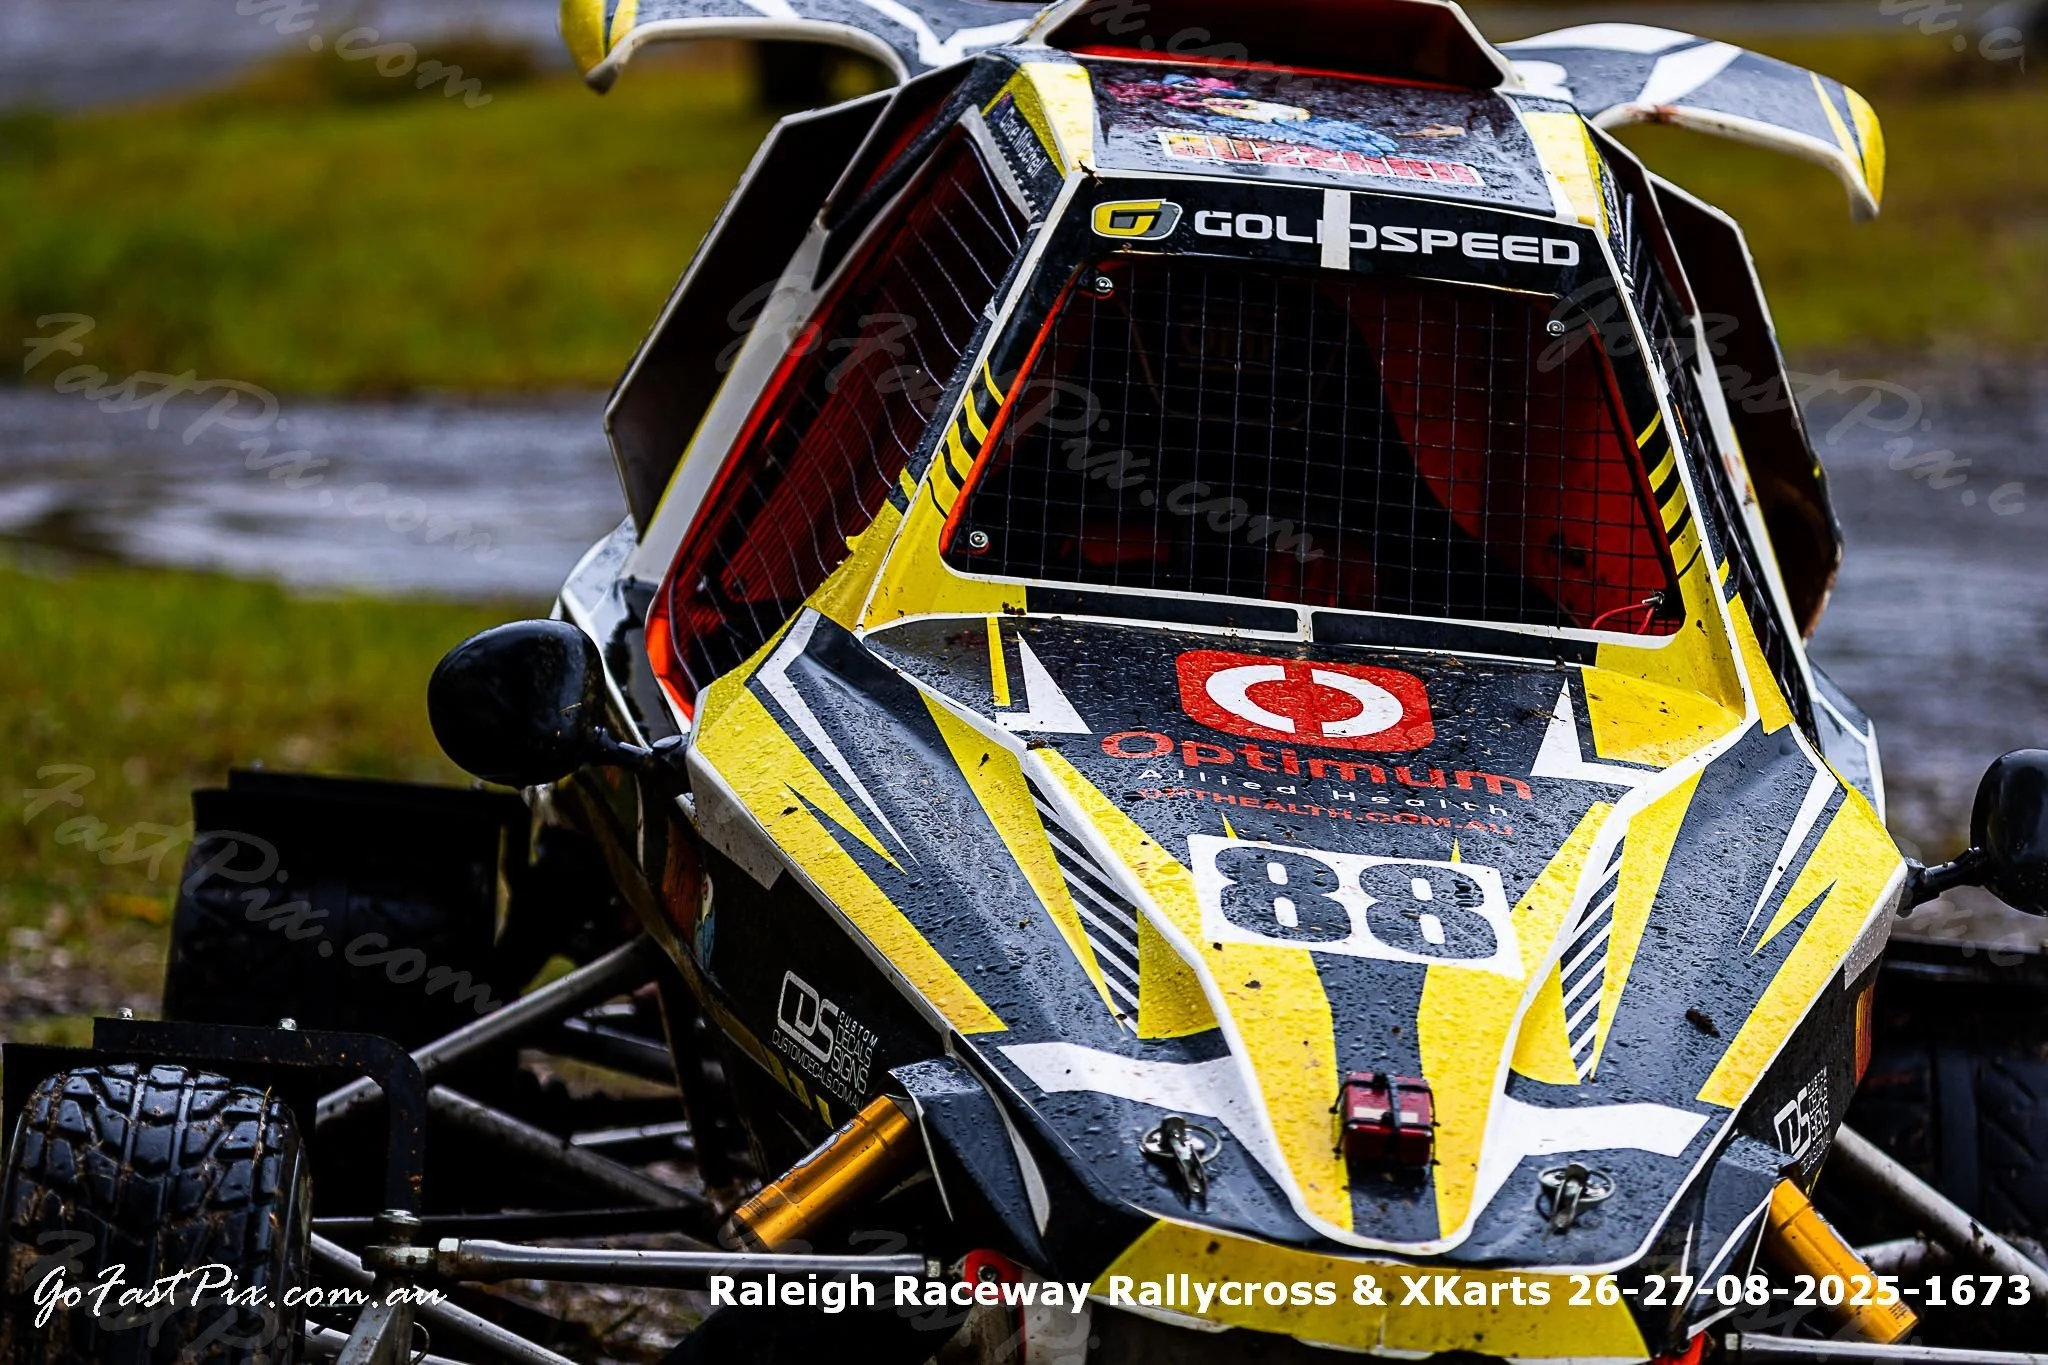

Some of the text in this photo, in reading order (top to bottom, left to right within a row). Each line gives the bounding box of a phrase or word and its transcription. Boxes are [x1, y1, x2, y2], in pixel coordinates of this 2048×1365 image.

[1101, 731, 1533, 800] Optimum
[1138, 768, 1508, 817] Allied Health
[1139, 788, 1513, 836] OPTHEALTH.COM.AU
[1213, 846, 1498, 960] 88
[835, 1024, 873, 1069] DECALS
[839, 1011, 879, 1048] CUSTOM
[831, 1046, 869, 1095] SIGNS
